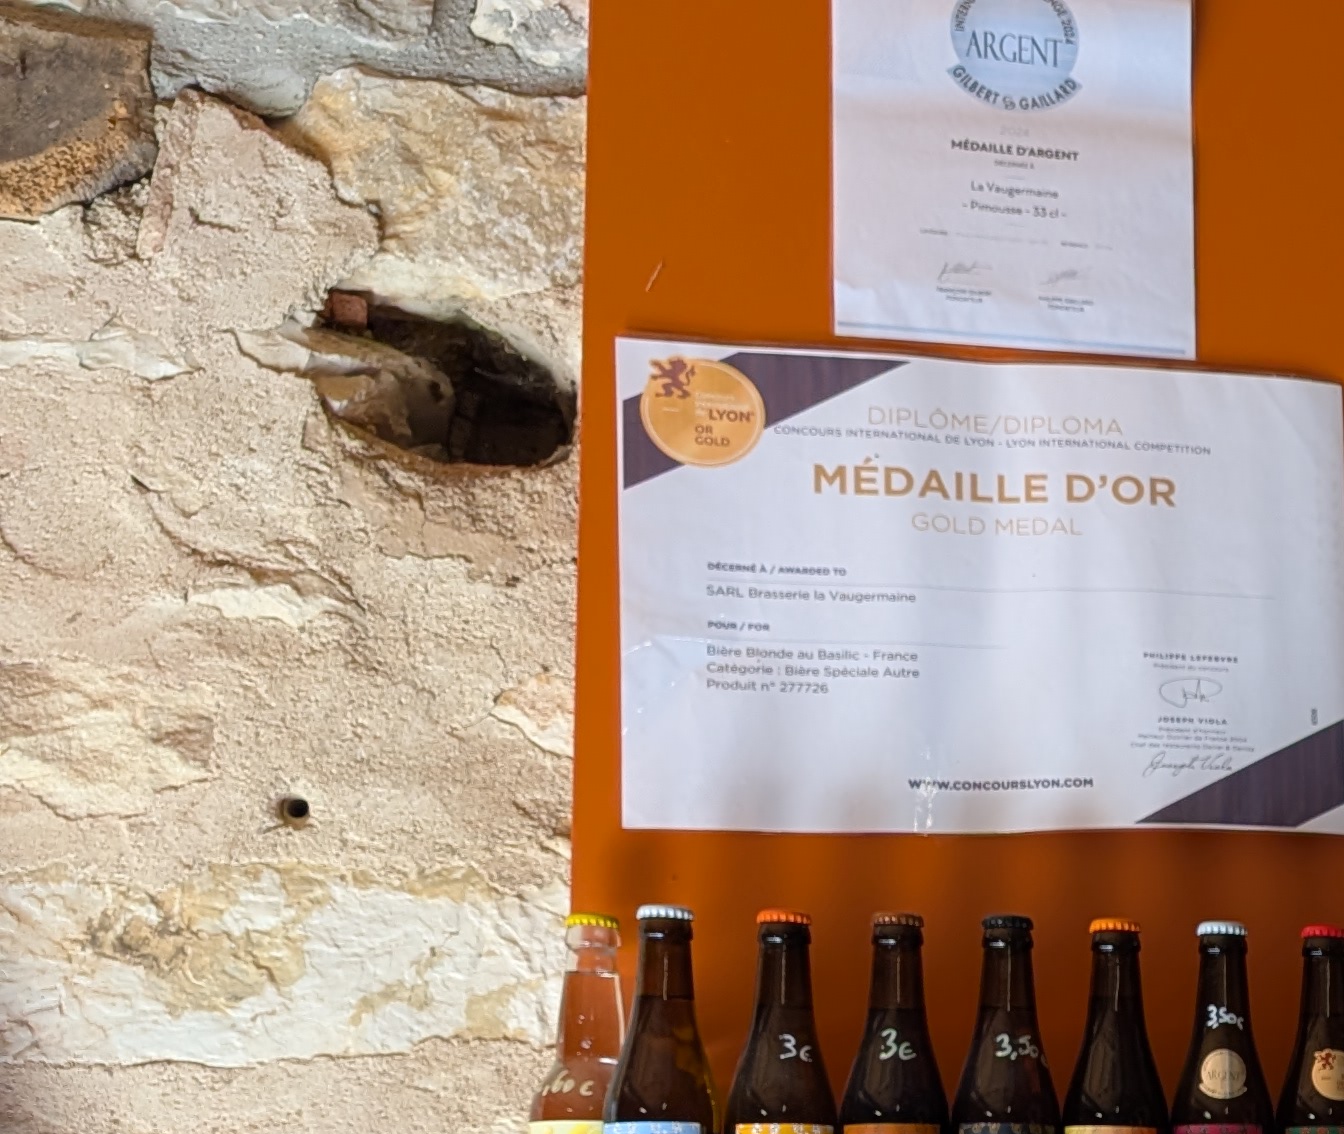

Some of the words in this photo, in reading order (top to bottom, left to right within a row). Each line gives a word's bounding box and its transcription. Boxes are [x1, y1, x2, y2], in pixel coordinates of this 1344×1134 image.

[966, 30, 1063, 68] ARGENT
[952, 65, 1000, 104] GILBERT
[1019, 78, 1078, 110] GAILLARD
[951, 139, 1013, 155] MÉDAILLE
[1017, 145, 1079, 161] D'ARGENT
[986, 182, 1059, 199] Vaugermaine
[694, 425, 713, 435] OR
[868, 405, 1123, 436] DIPLÔME/DIPLOMA
[694, 436, 730, 447] GOLD
[774, 425, 841, 438] CONCOURS
[845, 428, 941, 444] INTERNATIONAL
[946, 435, 960, 444] DE
[964, 436, 994, 447] LYON
[1006, 437, 1035, 448] LYON
[1039, 438, 1130, 450] INTERNATIONAL
[1134, 442, 1211, 455] COMPETITION
[812, 455, 1050, 504] MÉDAILLE
[1065, 473, 1177, 507] D'OR
[911, 512, 985, 535] GOLD
[994, 517, 1083, 536] MEDAL
[833, 568, 847, 577] TO
[707, 585, 744, 598] SARL
[748, 587, 810, 600] Brasserie
[814, 590, 825, 601] la
[829, 590, 917, 604] Vaugermaine
[707, 620, 737, 631] POUR
[707, 643, 742, 657] Bière
[746, 644, 793, 659] Blonde
[797, 651, 814, 661] au
[818, 647, 859, 661] Basilic
[873, 649, 918, 662] France
[707, 662, 774, 677] Catégorie
[784, 665, 820, 677] Bière
[823, 665, 879, 680] Spéciale
[882, 666, 920, 679] Autre
[707, 678, 757, 692] Produit
[780, 682, 829, 695] 277726
[908, 777, 1094, 792] WWW.CONCOURSLYON.COM
[779, 1034, 813, 1063] 3€
[880, 1028, 916, 1060] 3€
